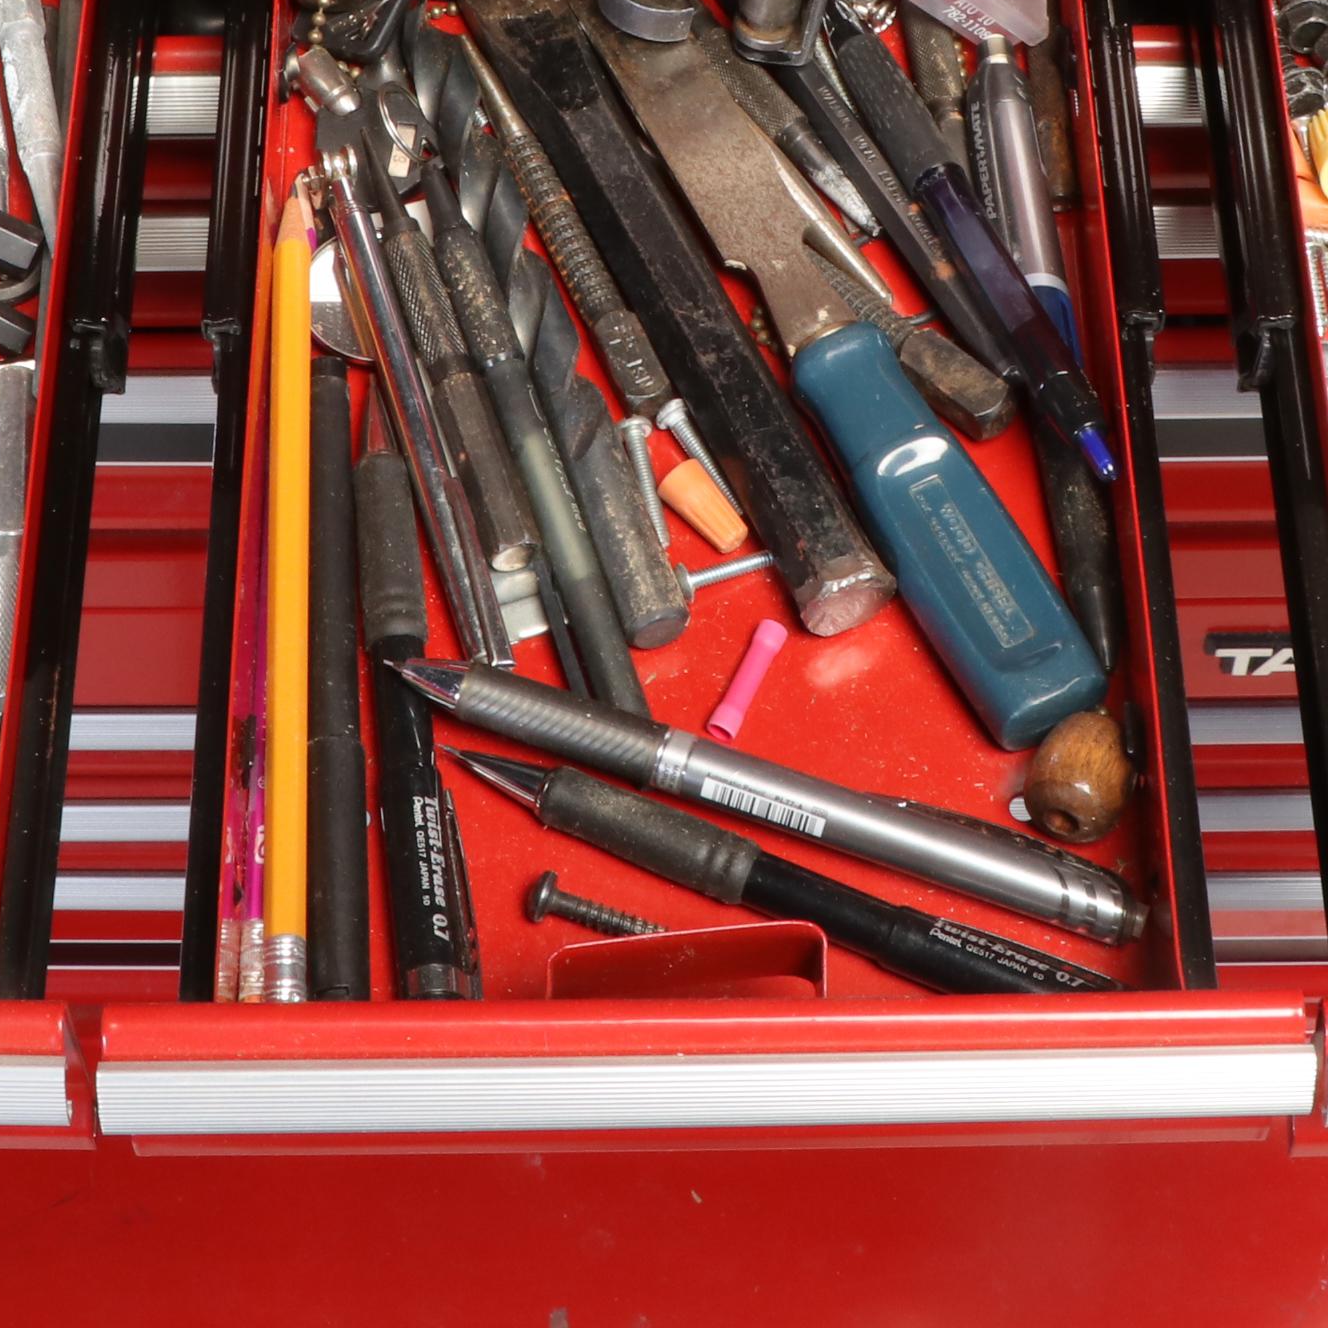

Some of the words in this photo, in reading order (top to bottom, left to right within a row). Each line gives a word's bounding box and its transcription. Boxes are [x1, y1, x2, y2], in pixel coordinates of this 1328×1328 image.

[1215, 647, 1295, 676] TA
[410, 795, 427, 827] Pentel
[423, 794, 446, 906] Twist-Erase
[417, 860, 431, 889] JAPAN
[431, 912, 450, 942] 0.7
[995, 955, 1028, 974] JAPAN
[1054, 969, 1084, 989] 0.7
